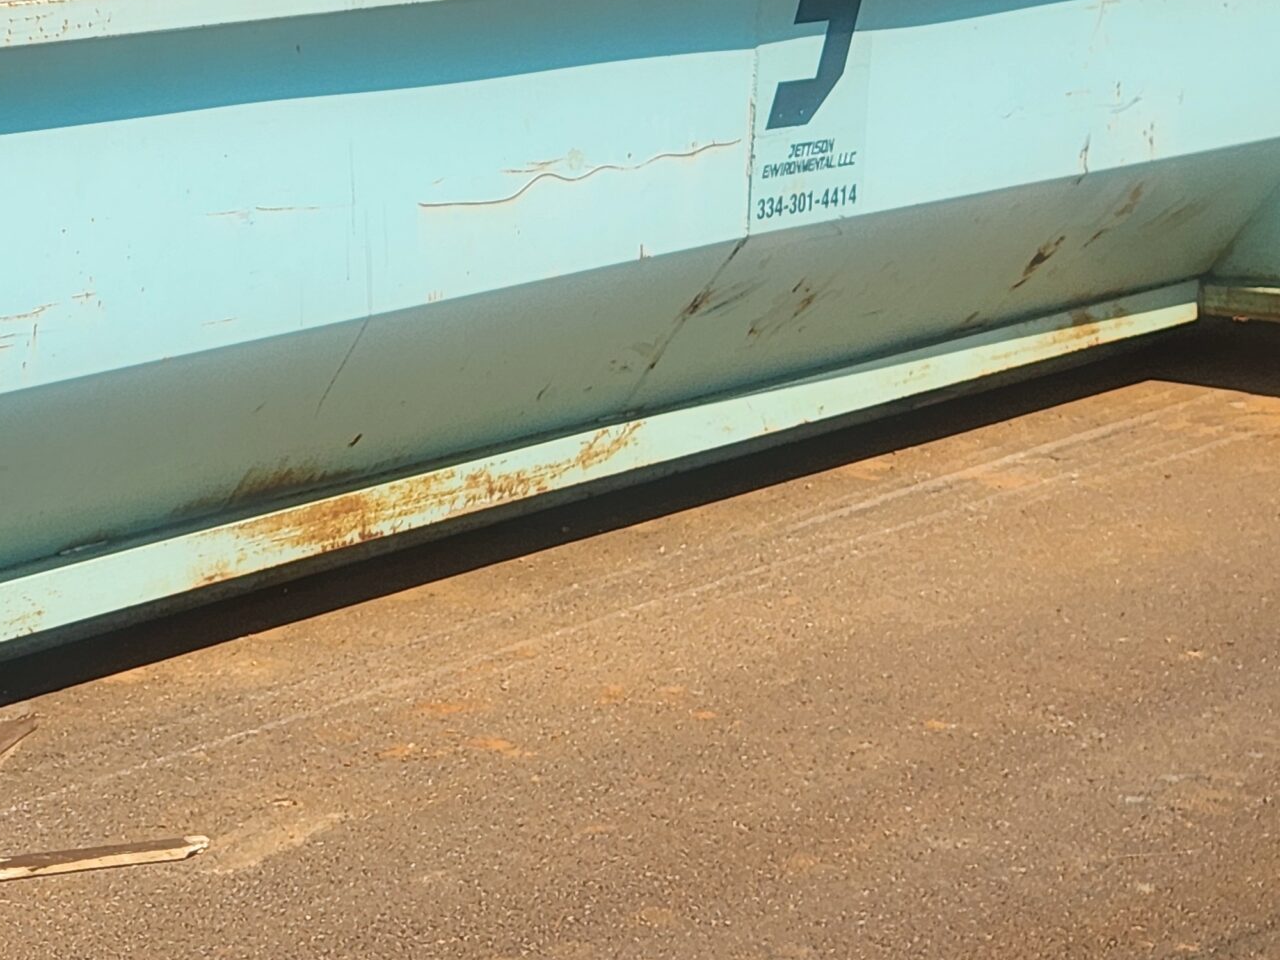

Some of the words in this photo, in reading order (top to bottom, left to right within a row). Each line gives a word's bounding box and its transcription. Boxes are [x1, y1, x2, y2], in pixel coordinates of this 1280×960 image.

[788, 138, 836, 159] JETTISON
[762, 155, 837, 179] ENVIRONMENTAL
[837, 151, 857, 168] LLC
[757, 183, 857, 220] 334-301-4414
